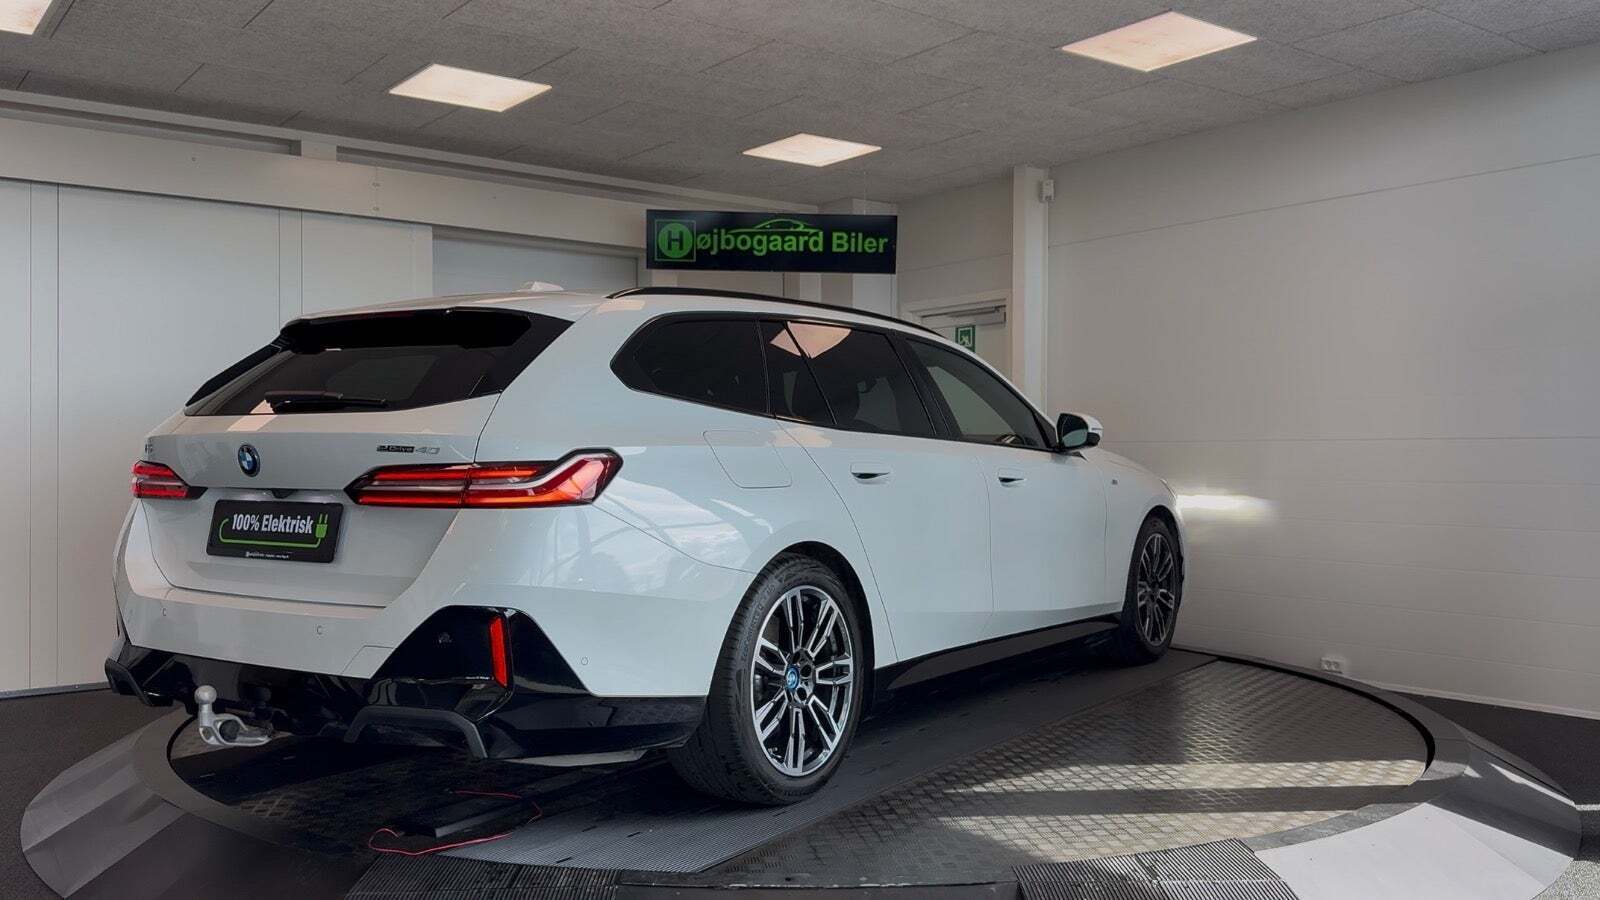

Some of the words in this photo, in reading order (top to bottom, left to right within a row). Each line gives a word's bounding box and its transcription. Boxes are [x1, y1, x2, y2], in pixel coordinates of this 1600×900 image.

[832, 232, 888, 253] Biler
[231, 513, 260, 531] 100%
[261, 514, 314, 534] Elektrisk
